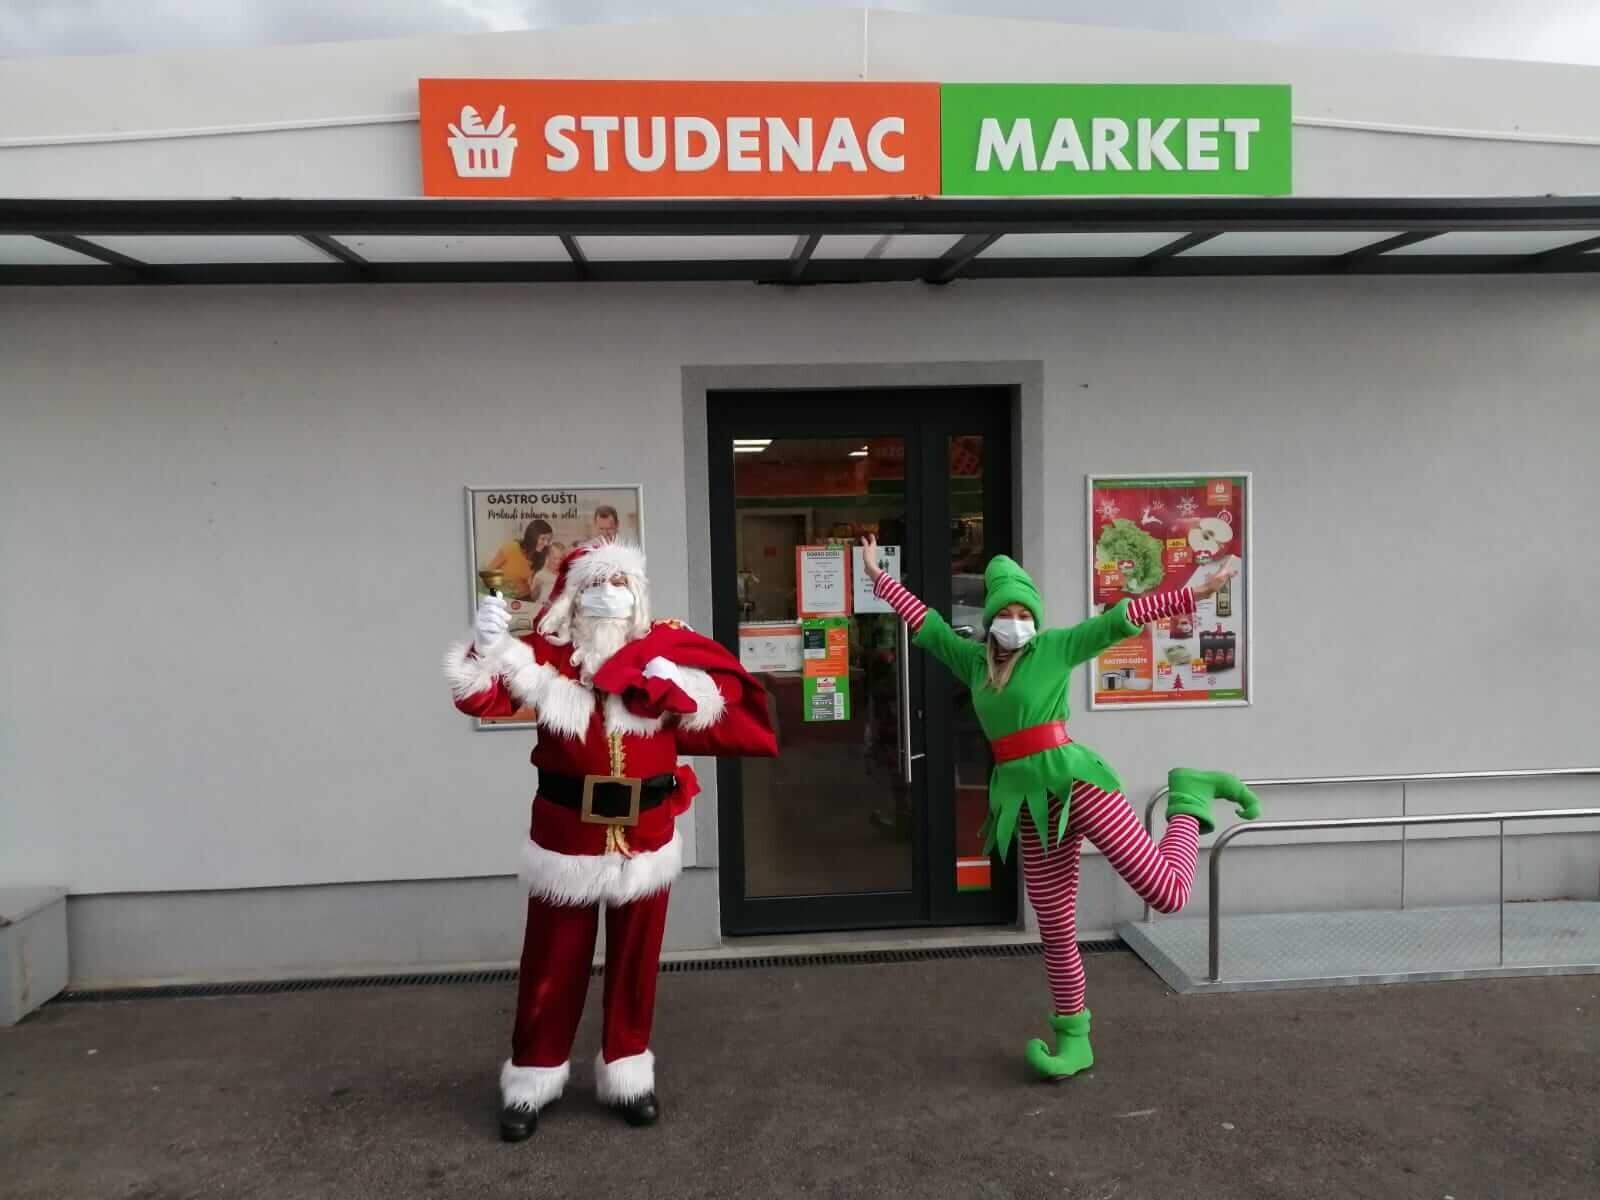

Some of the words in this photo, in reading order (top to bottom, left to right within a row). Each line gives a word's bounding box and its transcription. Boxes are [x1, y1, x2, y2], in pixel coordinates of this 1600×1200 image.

[544, 115, 905, 172] STUDENAC
[975, 117, 1260, 171] MARKET
[487, 494, 538, 504] GASTRO
[541, 491, 577, 504] GUŠTI
